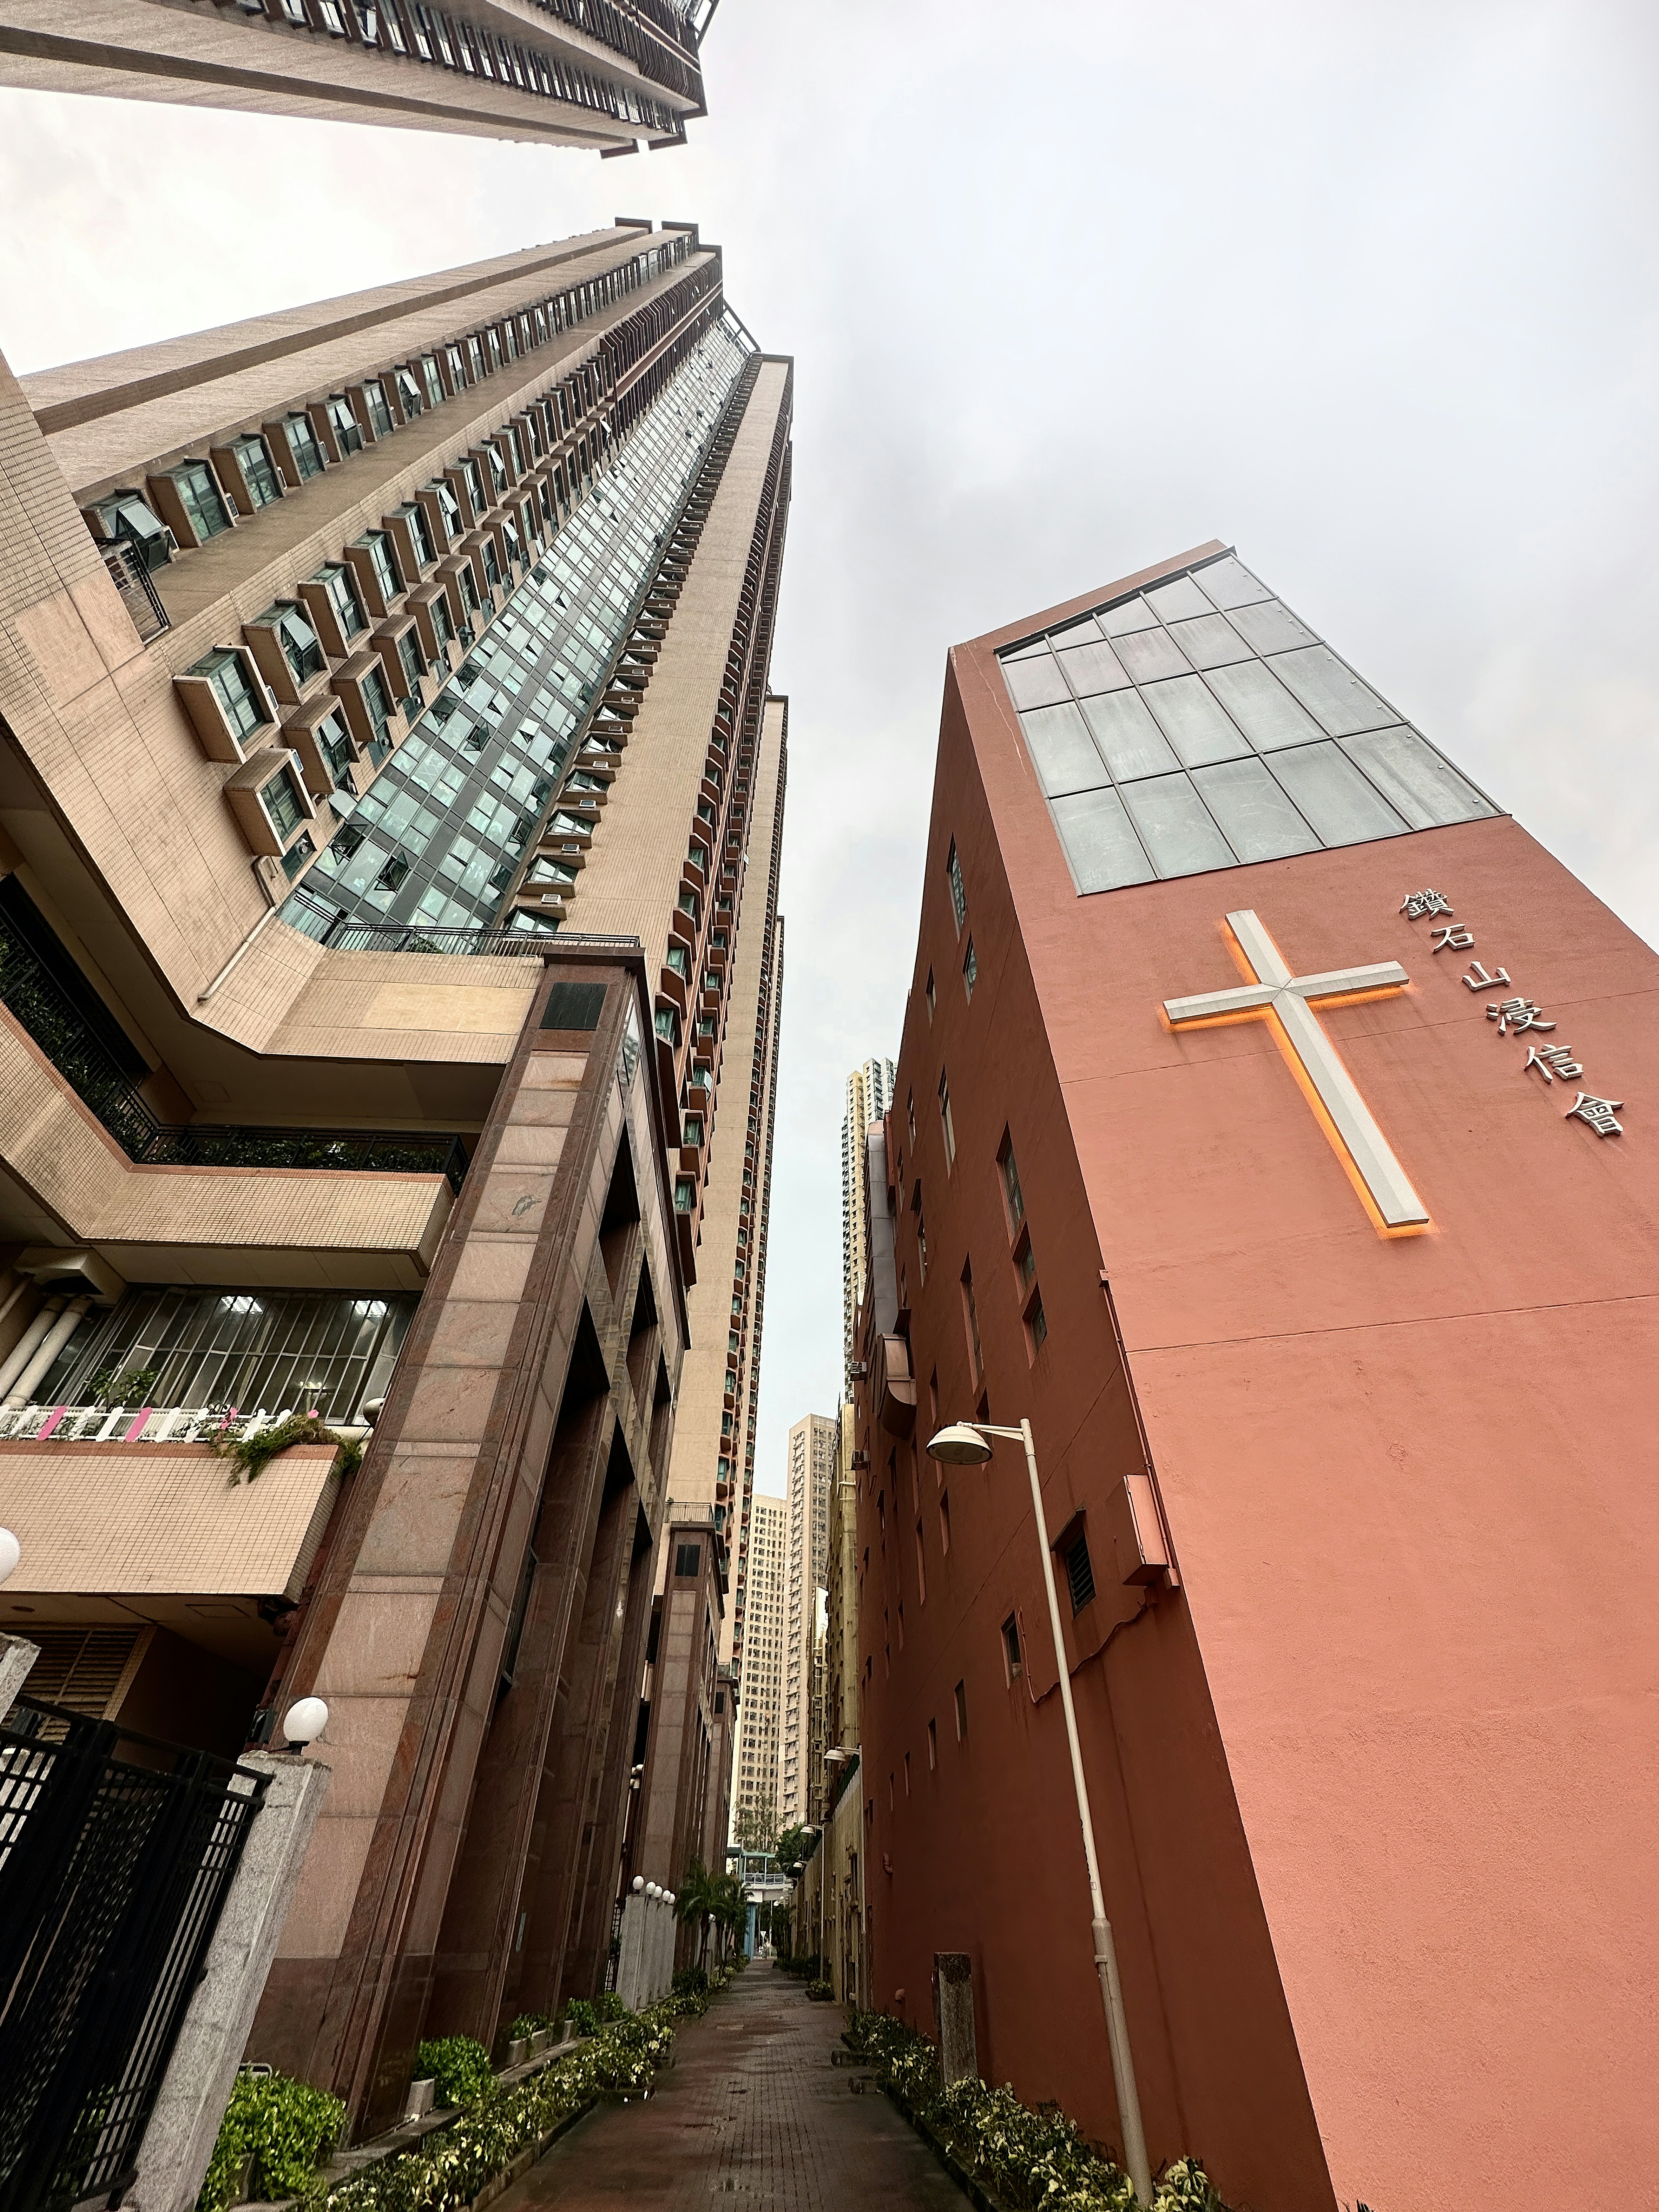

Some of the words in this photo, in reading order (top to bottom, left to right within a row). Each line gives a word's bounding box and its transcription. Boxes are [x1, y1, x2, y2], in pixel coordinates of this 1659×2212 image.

[1399, 888, 1625, 1137] 鑽石山浸信會
